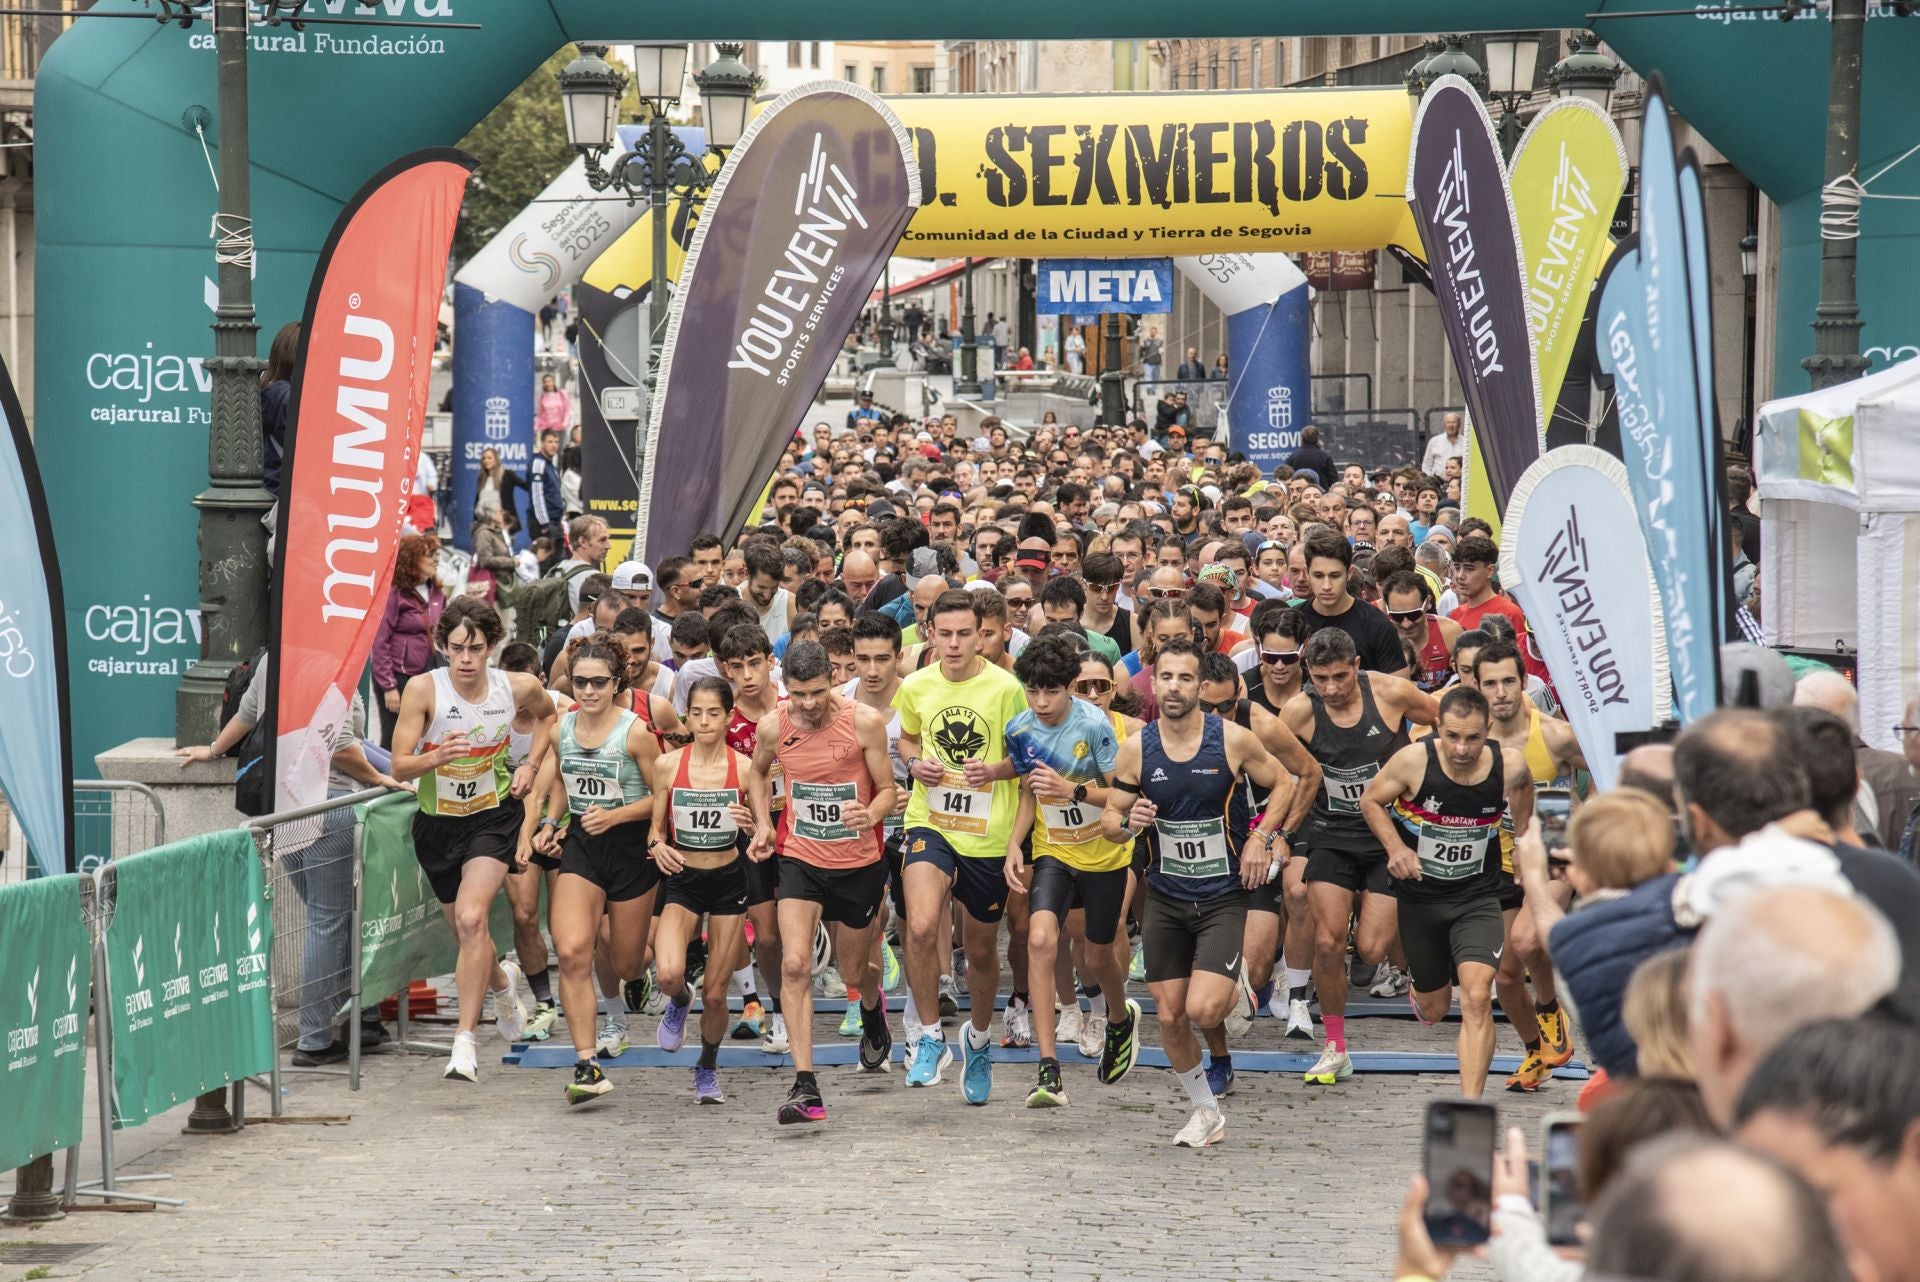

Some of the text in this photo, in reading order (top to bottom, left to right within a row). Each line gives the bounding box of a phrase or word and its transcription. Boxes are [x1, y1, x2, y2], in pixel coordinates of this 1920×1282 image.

[314, 34, 445, 55] Fundación
[977, 116, 1369, 217] SEXMEROS
[564, 215, 611, 261] 2025
[903, 224, 1312, 241] Comunidad de la Ciudad y Tierra de Segovia
[1198, 254, 1235, 284] 025
[1050, 270, 1161, 302] META
[1545, 248, 1585, 353] SPORTS SERVICES
[777, 264, 845, 386] SPORTS SERVICES
[91, 404, 181, 425] cajarural
[1248, 431, 1302, 450] SEGOVI
[465, 442, 527, 460] SEOVIA
[88, 656, 179, 677] cajarural
[945, 708, 973, 719] ALA 12
[456, 782, 477, 800] 42
[943, 792, 972, 813] 141
[689, 810, 722, 829] 142
[807, 803, 840, 823] 159
[1441, 815, 1478, 826] SPARTANS
[1174, 841, 1206, 860] 101
[1434, 843, 1473, 863] 266
